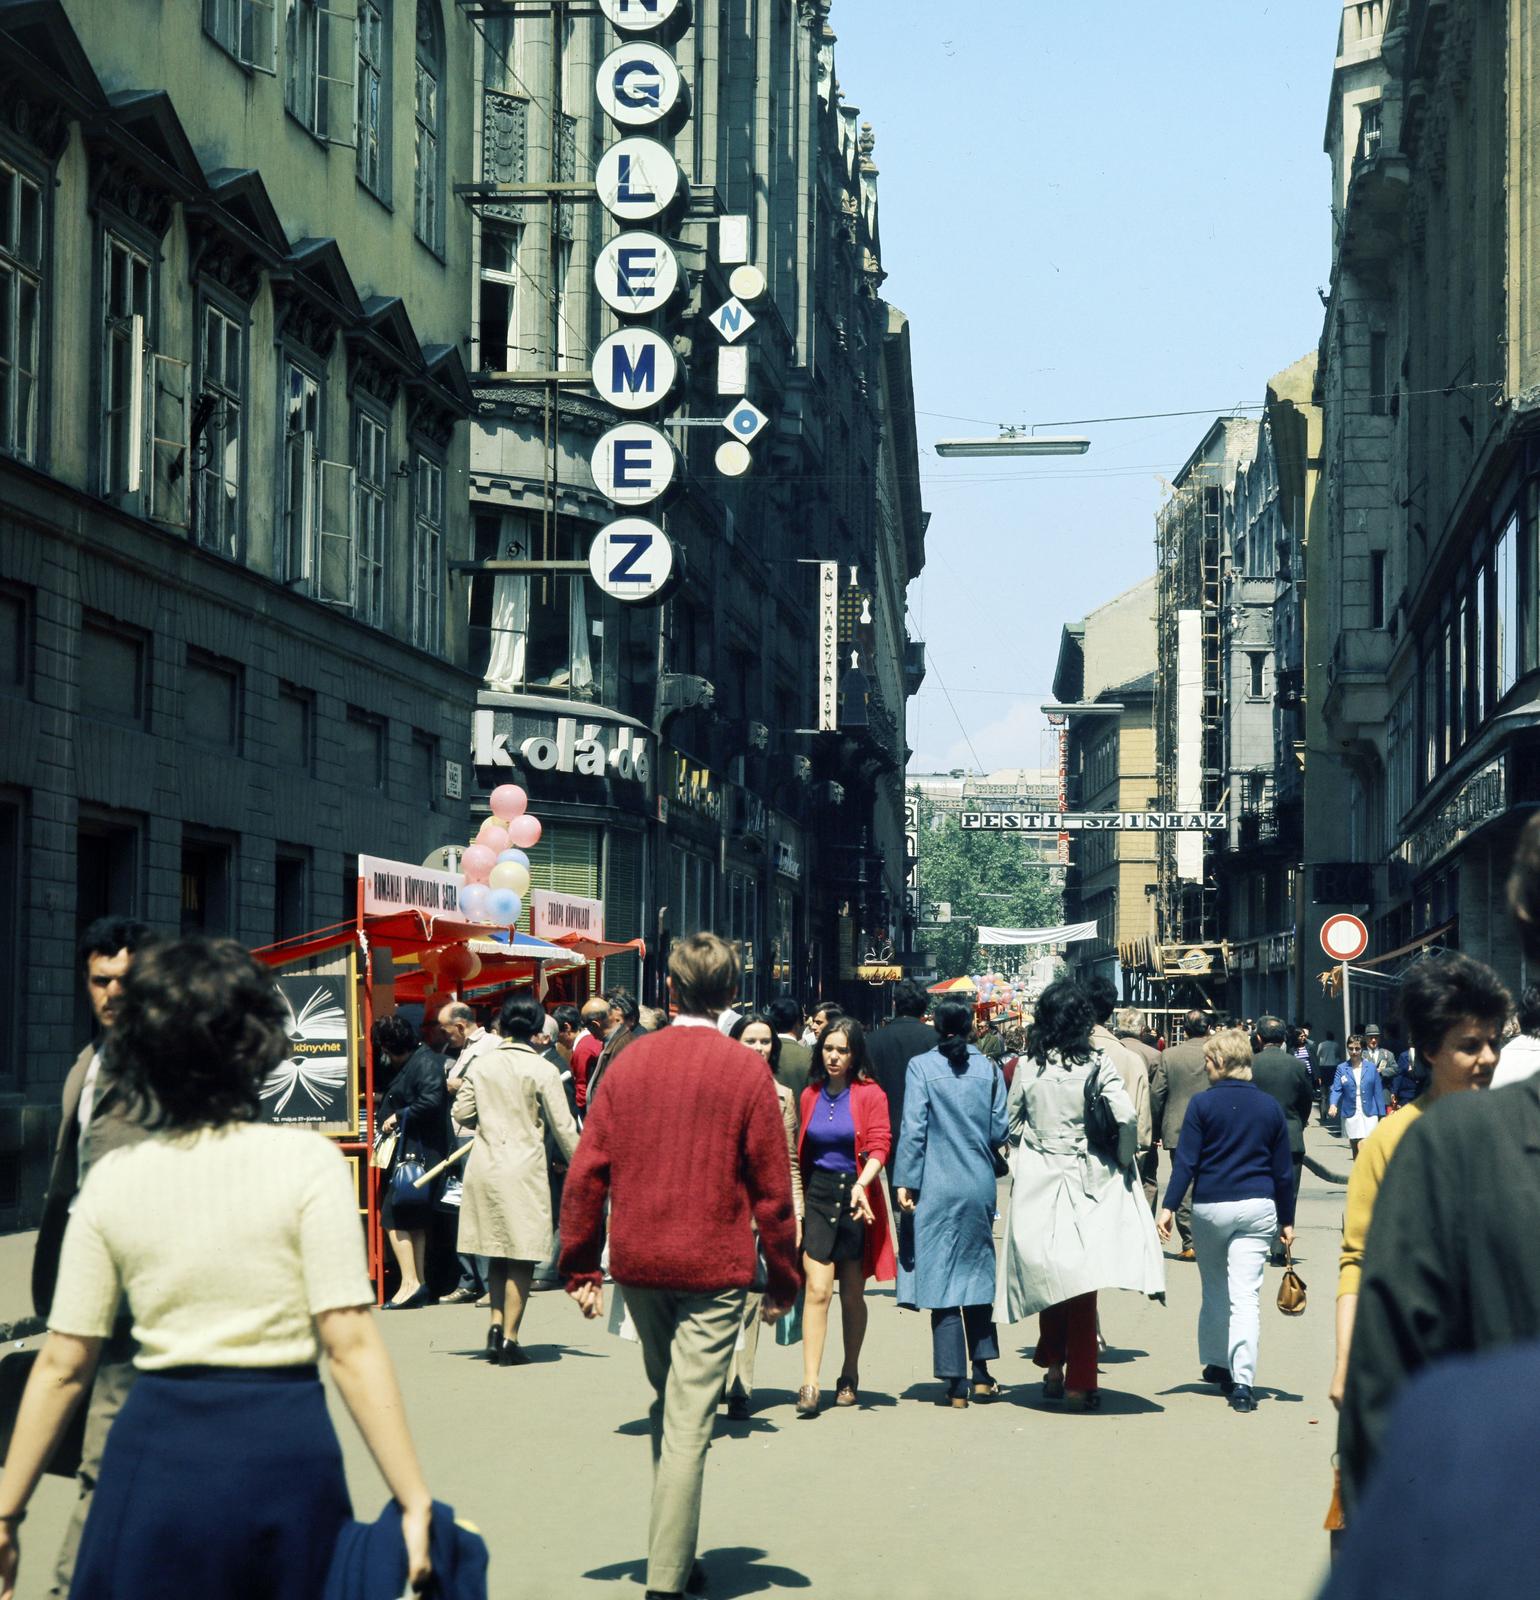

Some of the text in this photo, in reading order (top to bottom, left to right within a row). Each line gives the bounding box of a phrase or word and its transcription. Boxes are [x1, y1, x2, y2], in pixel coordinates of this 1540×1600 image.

[610, 0, 660, 583] GLEMEZ
[963, 814, 1058, 828] PESTI
[442, 882, 457, 911] SÁTRA
